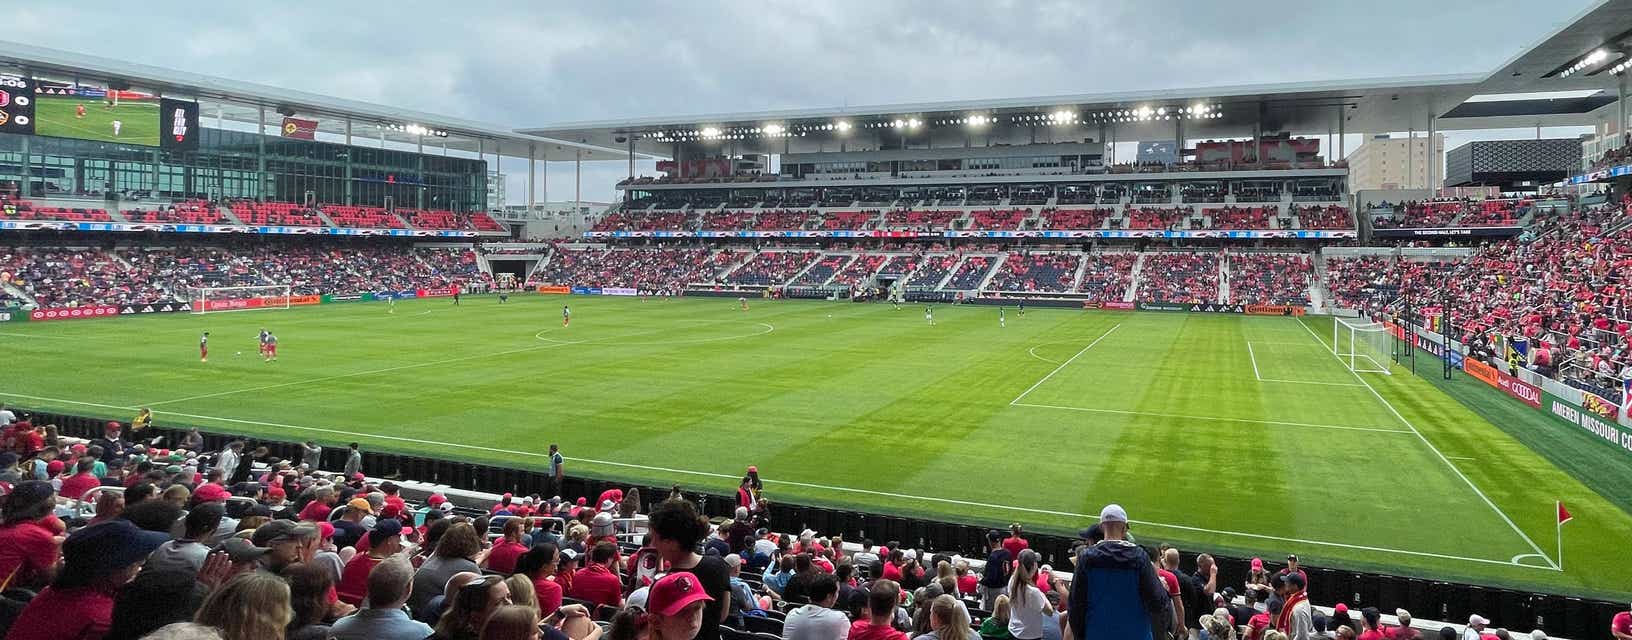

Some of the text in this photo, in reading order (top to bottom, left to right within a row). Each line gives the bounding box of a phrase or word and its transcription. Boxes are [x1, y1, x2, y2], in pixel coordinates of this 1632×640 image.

[14, 96, 29, 106] 0
[14, 115, 29, 125] 0
[1497, 376, 1510, 389] Audi
[1551, 400, 1580, 425] AMEREN
[1581, 413, 1619, 445] MISSOURI
